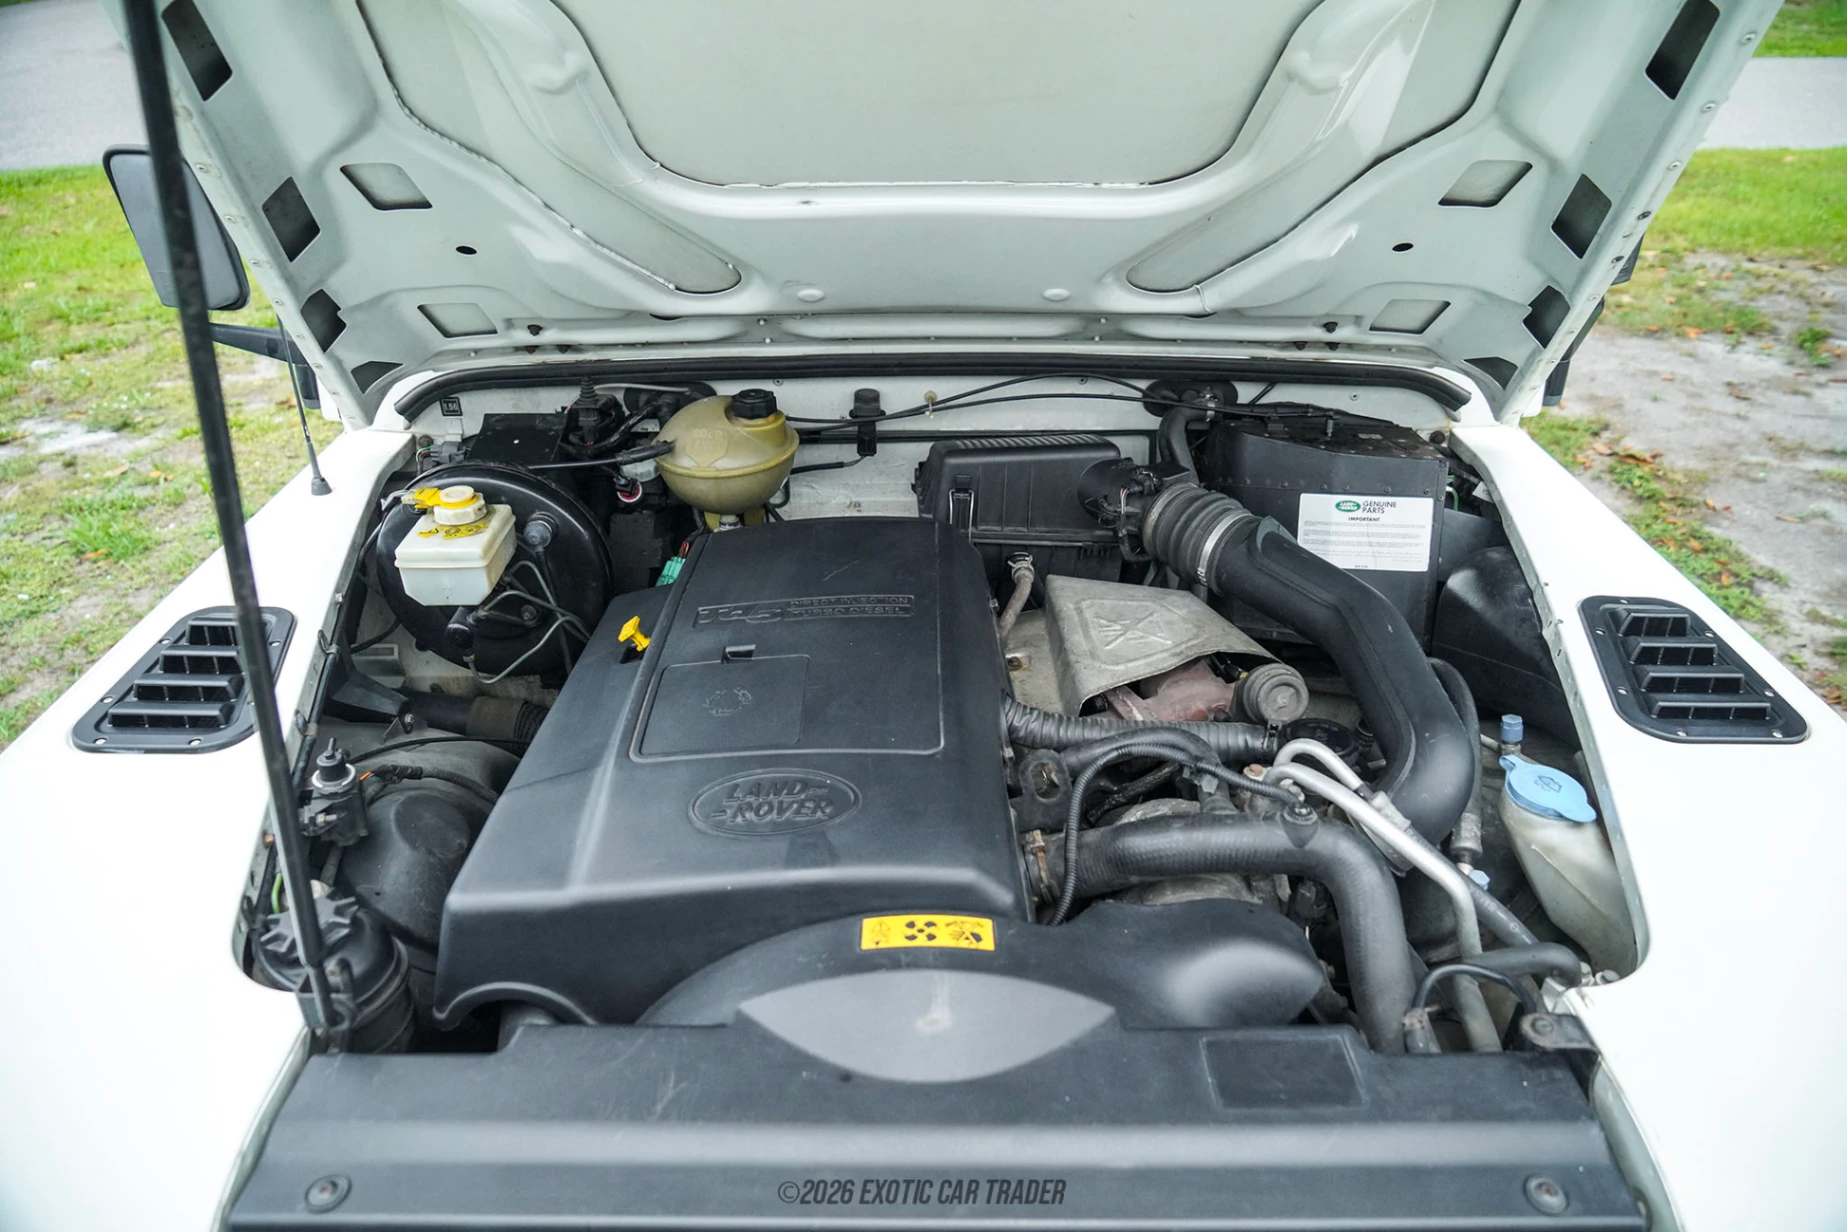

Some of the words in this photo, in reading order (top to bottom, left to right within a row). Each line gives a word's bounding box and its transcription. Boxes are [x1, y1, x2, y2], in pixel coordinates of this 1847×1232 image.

[1362, 500, 1397, 508] GENUINE
[724, 780, 810, 803] LAND
[728, 799, 834, 823] ROVER
